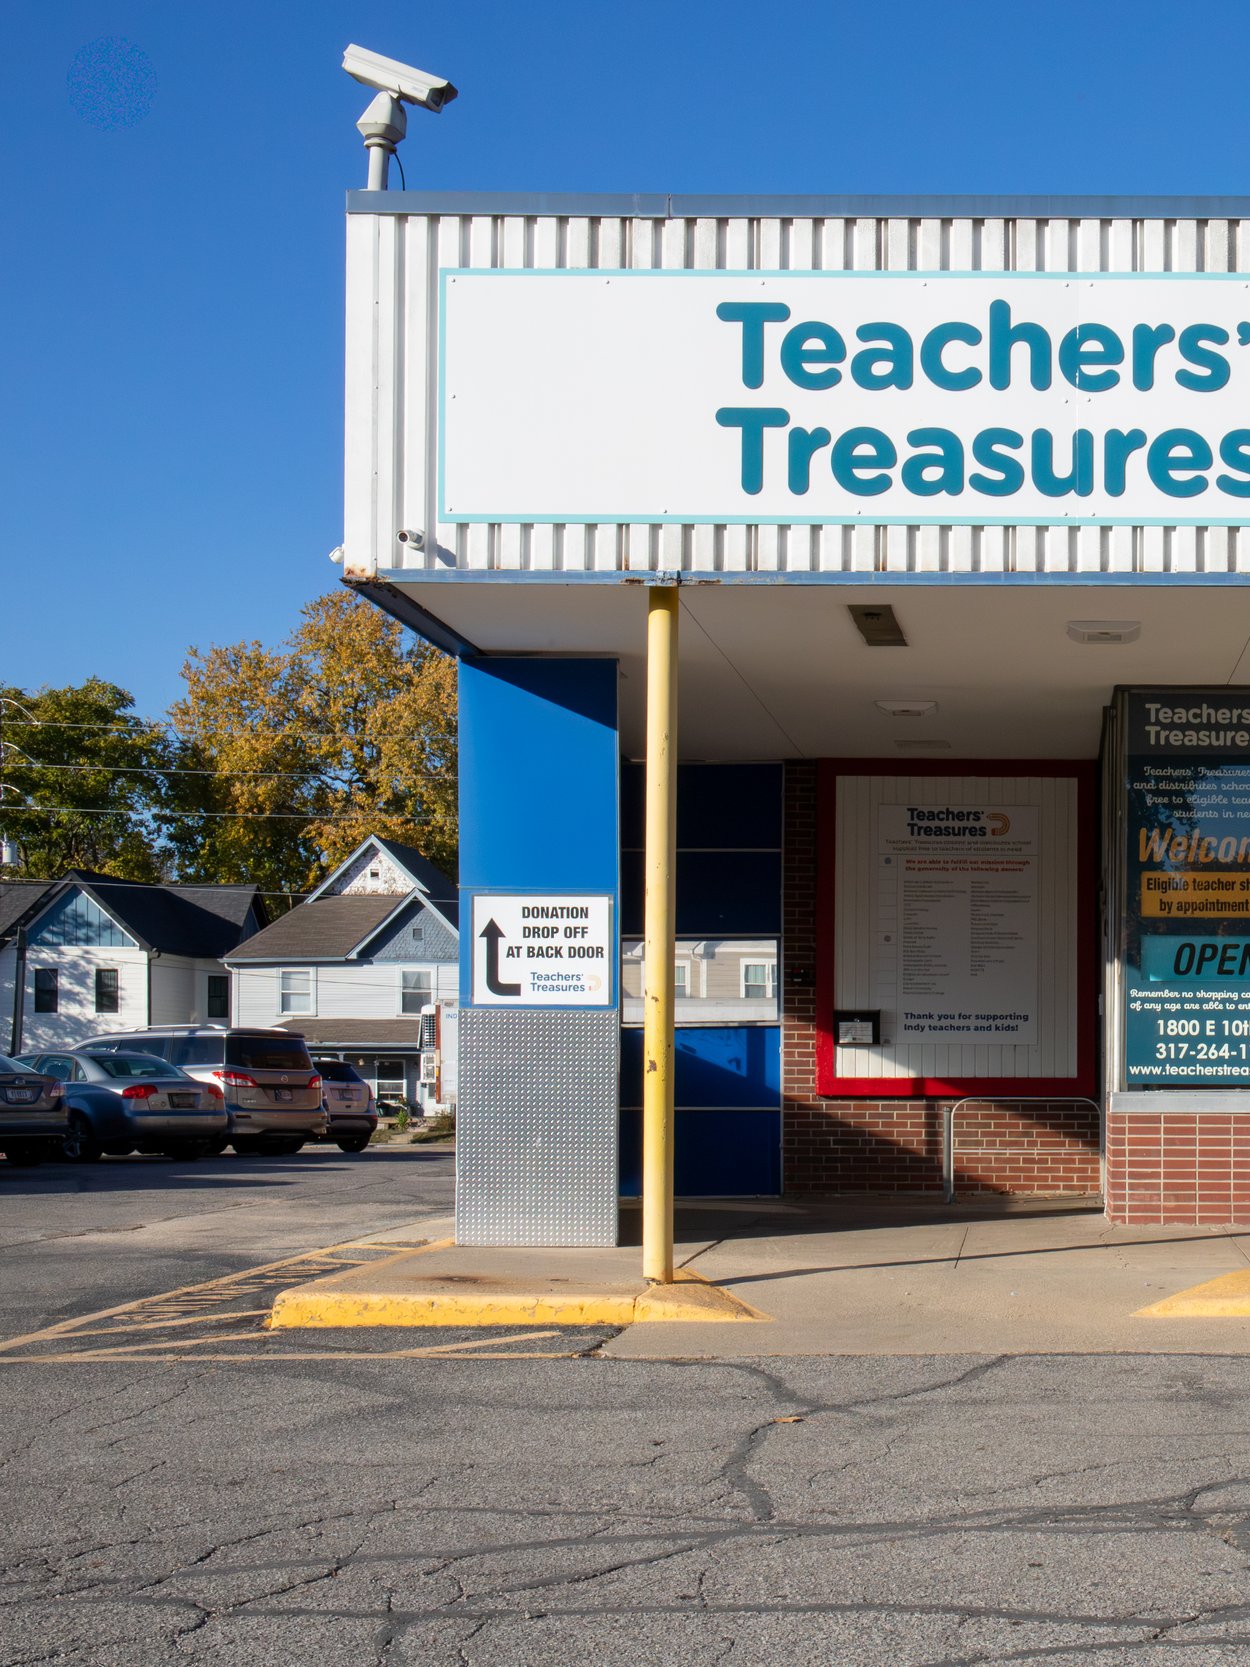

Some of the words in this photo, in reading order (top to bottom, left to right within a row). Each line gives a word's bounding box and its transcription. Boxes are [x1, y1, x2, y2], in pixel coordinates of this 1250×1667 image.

[1198, 766, 1250, 777] Treasures
[1133, 781, 1157, 790] and
[1158, 781, 1217, 791] distributes
[1145, 794, 1169, 806] free
[1172, 795, 1184, 804] to
[1187, 794, 1228, 806] eligible
[1173, 809, 1219, 818] students
[1222, 809, 1234, 818] in
[907, 822, 987, 837] Treasures
[1146, 878, 1189, 893] Eligible
[1193, 878, 1235, 891] teacher
[1159, 899, 1172, 914] by
[1176, 899, 1249, 914] appointment
[522, 906, 589, 919] DONATION
[523, 926, 559, 939] DROP
[564, 926, 589, 939] OFF
[506, 946, 522, 959] AT
[527, 946, 563, 959] BACK
[568, 946, 604, 959] DOOR
[530, 983, 585, 992] Treasures
[1130, 989, 1180, 998] Remember
[1196, 990, 1238, 1000] shopping
[1130, 1001, 1142, 1011] of
[1144, 1003, 1161, 1011] any
[1164, 1003, 1181, 1012] age
[1202, 1001, 1224, 1010] able
[1226, 1002, 1236, 1010] to
[904, 1012, 934, 1020] Thank
[937, 1014, 955, 1022] you
[958, 1012, 972, 1020] for
[974, 1012, 1029, 1022] supporting
[904, 1023, 925, 1032] Indy
[1157, 1019, 1200, 1036] 1800
[1205, 1020, 1216, 1036] E
